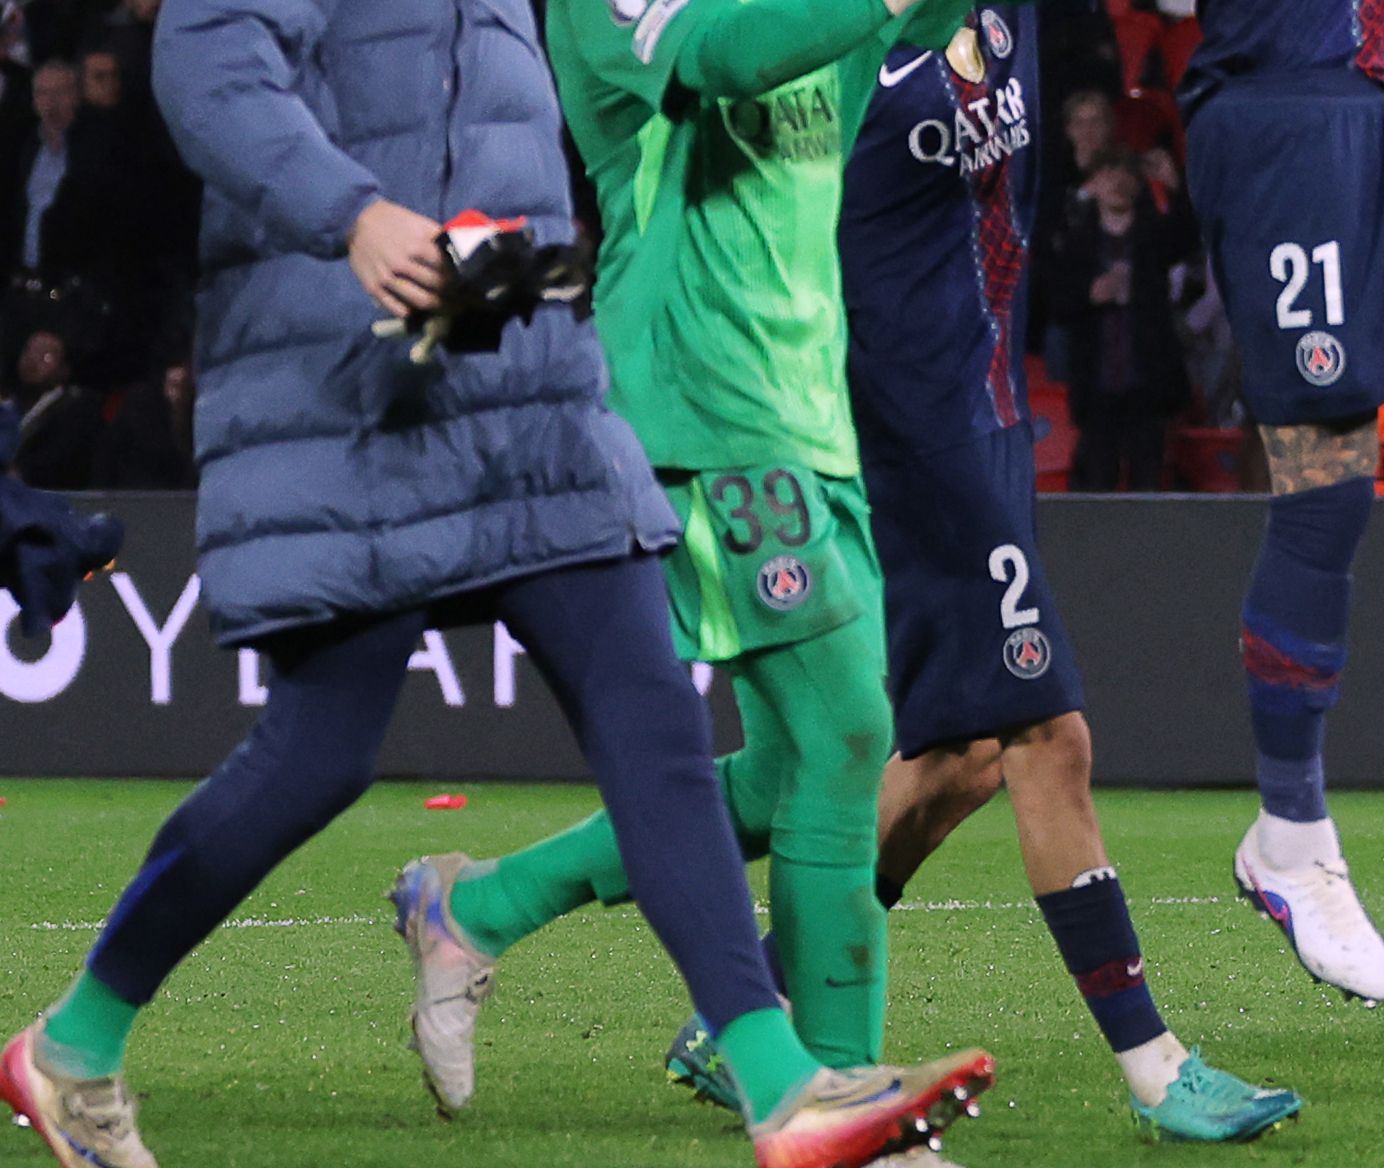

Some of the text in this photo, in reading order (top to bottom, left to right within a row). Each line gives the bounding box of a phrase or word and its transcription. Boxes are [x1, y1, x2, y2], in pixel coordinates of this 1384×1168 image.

[1270, 240, 1344, 329] 21
[712, 468, 811, 556] 39
[989, 544, 1040, 629] 2
